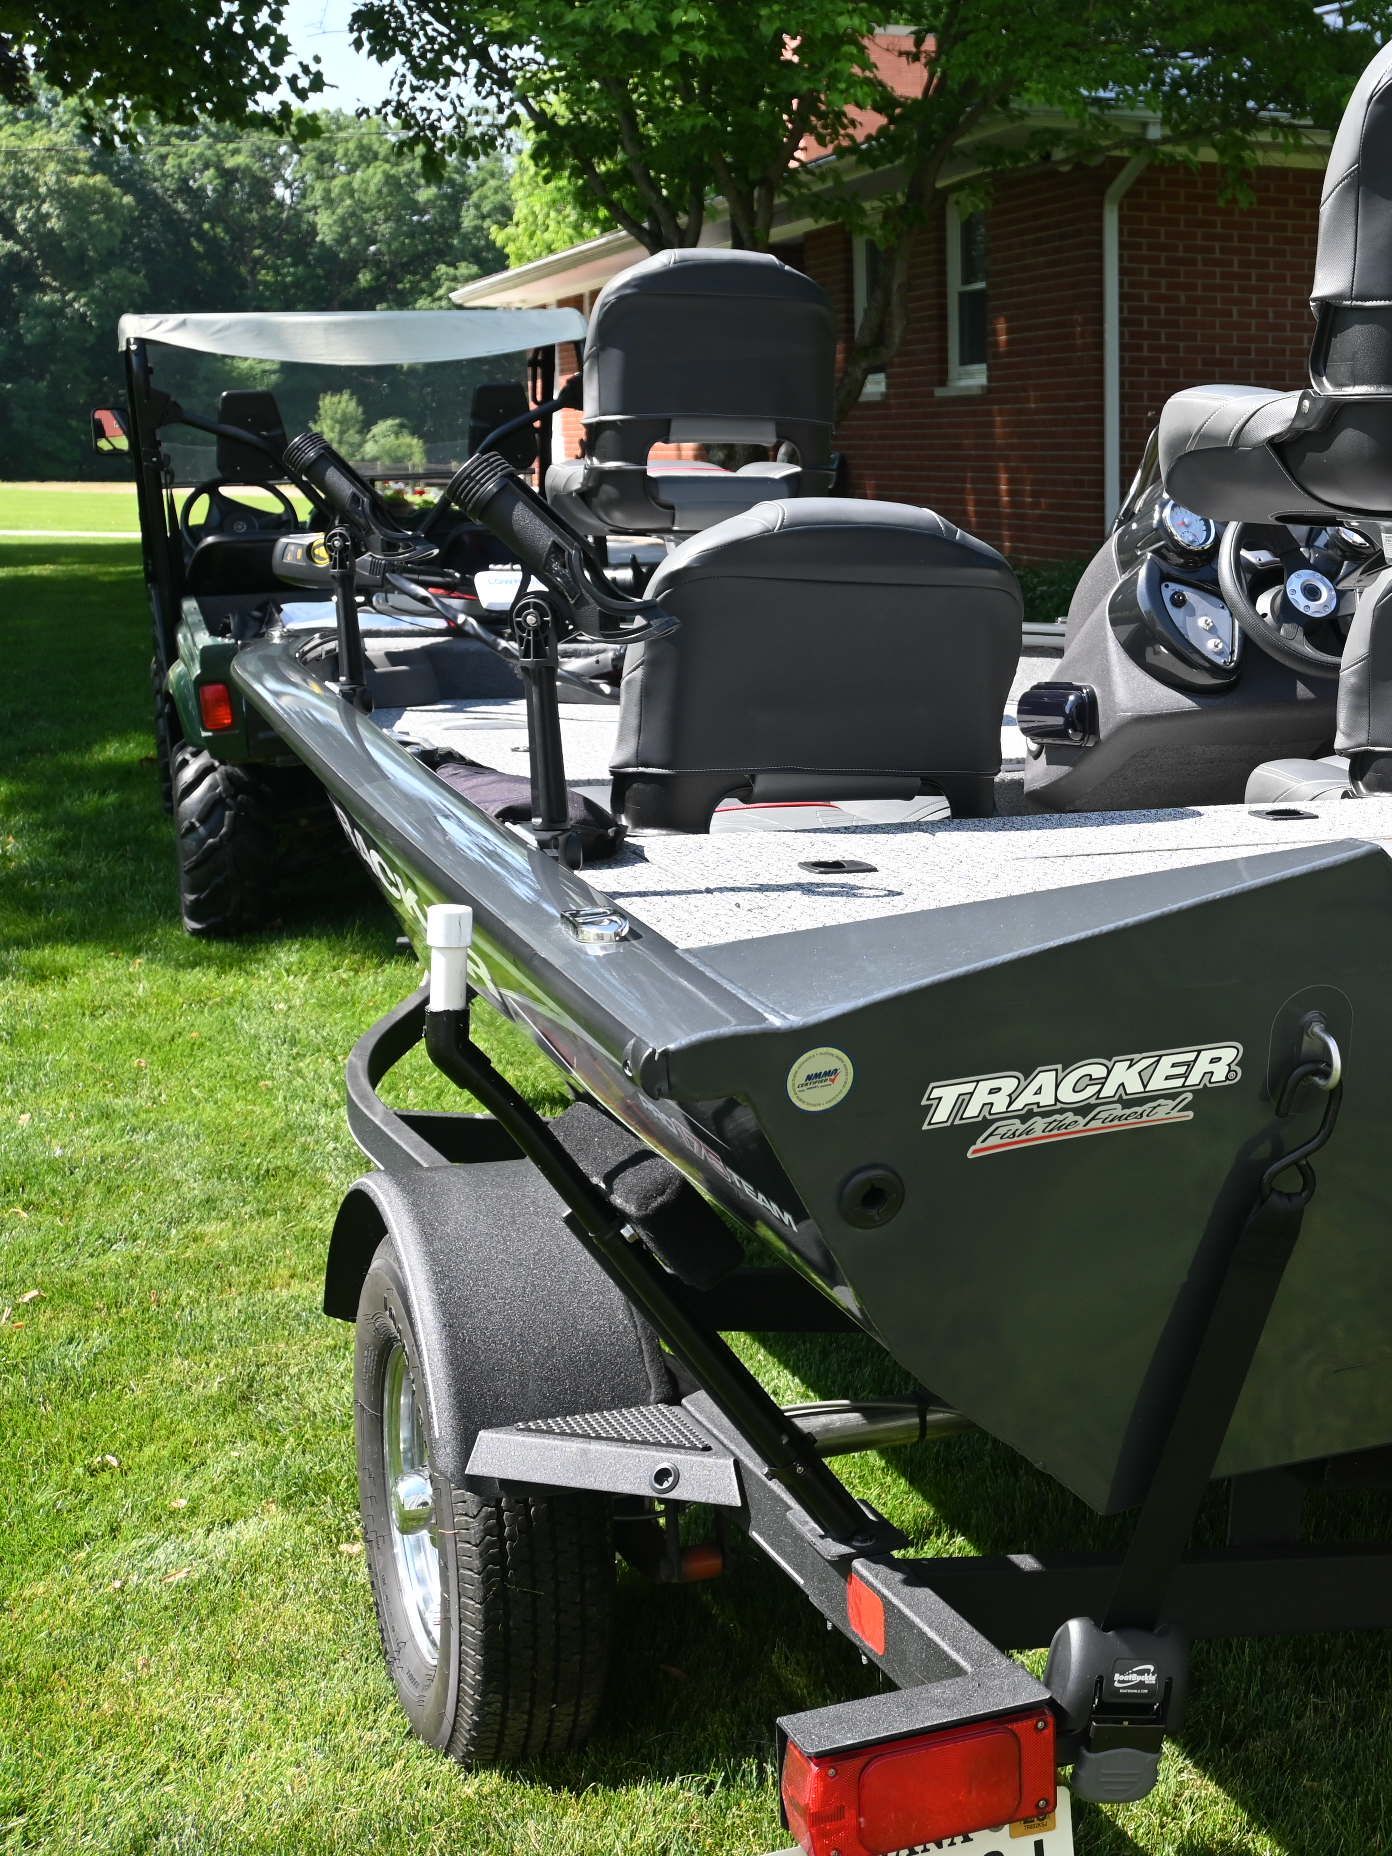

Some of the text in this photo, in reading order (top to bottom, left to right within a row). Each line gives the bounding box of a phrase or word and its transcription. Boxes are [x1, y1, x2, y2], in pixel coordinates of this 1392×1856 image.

[980, 1120, 1037, 1144] Fish
[1042, 1114, 1081, 1134] the
[726, 1167, 799, 1233] TEAM
